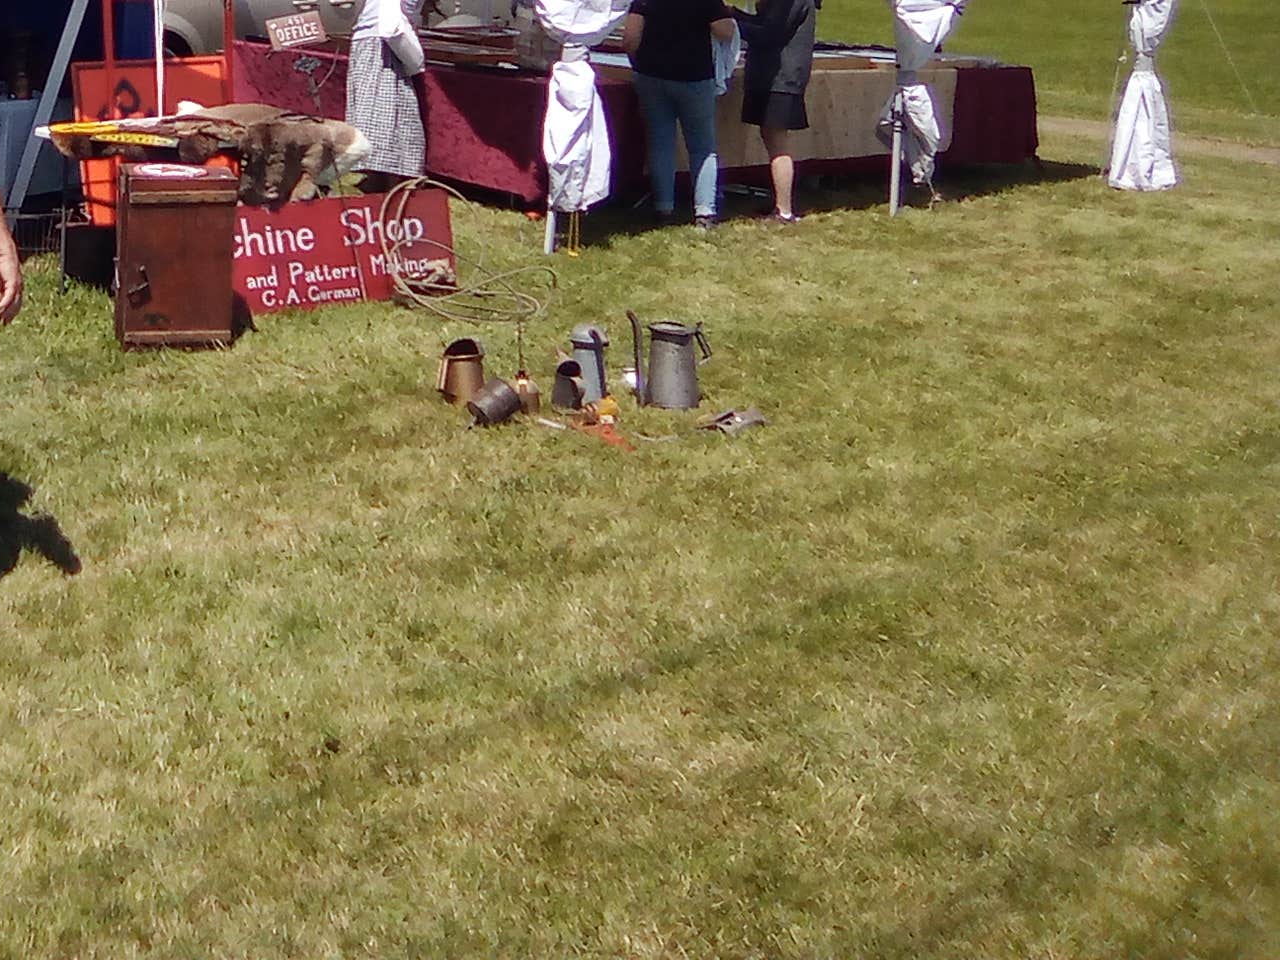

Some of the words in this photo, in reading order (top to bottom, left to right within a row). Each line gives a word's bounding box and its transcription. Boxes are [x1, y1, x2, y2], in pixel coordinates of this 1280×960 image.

[276, 22, 320, 42] OFFICE
[340, 206, 424, 247] Shop
[246, 265, 278, 289] and
